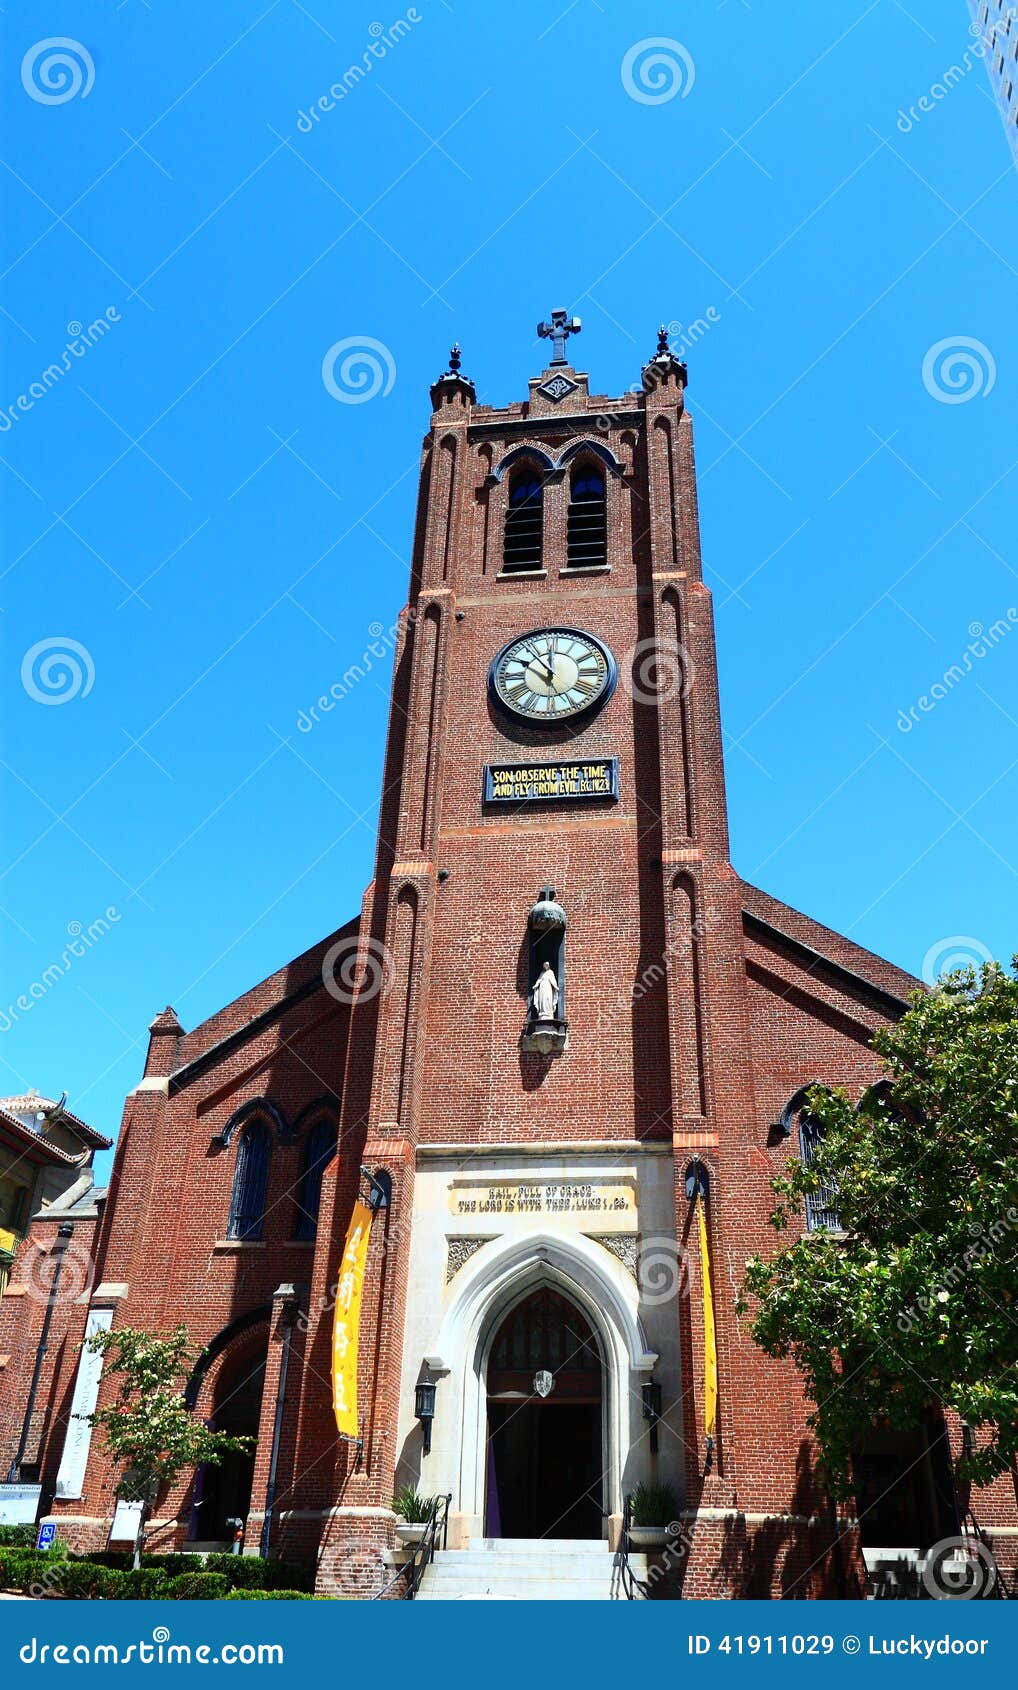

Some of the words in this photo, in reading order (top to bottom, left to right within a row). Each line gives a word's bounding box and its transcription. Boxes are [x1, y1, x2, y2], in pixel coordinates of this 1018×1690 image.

[516, 768, 558, 782] OBSERVE
[560, 767, 579, 780] THE
[582, 765, 606, 778] TIME
[493, 783, 513, 796] AND
[513, 782, 530, 795] FLY
[533, 782, 558, 794] FROM
[458, 1200, 476, 1213] THE
[479, 1200, 503, 1213] LORD
[504, 1200, 515, 1213] IS
[517, 1199, 542, 1212] WITH
